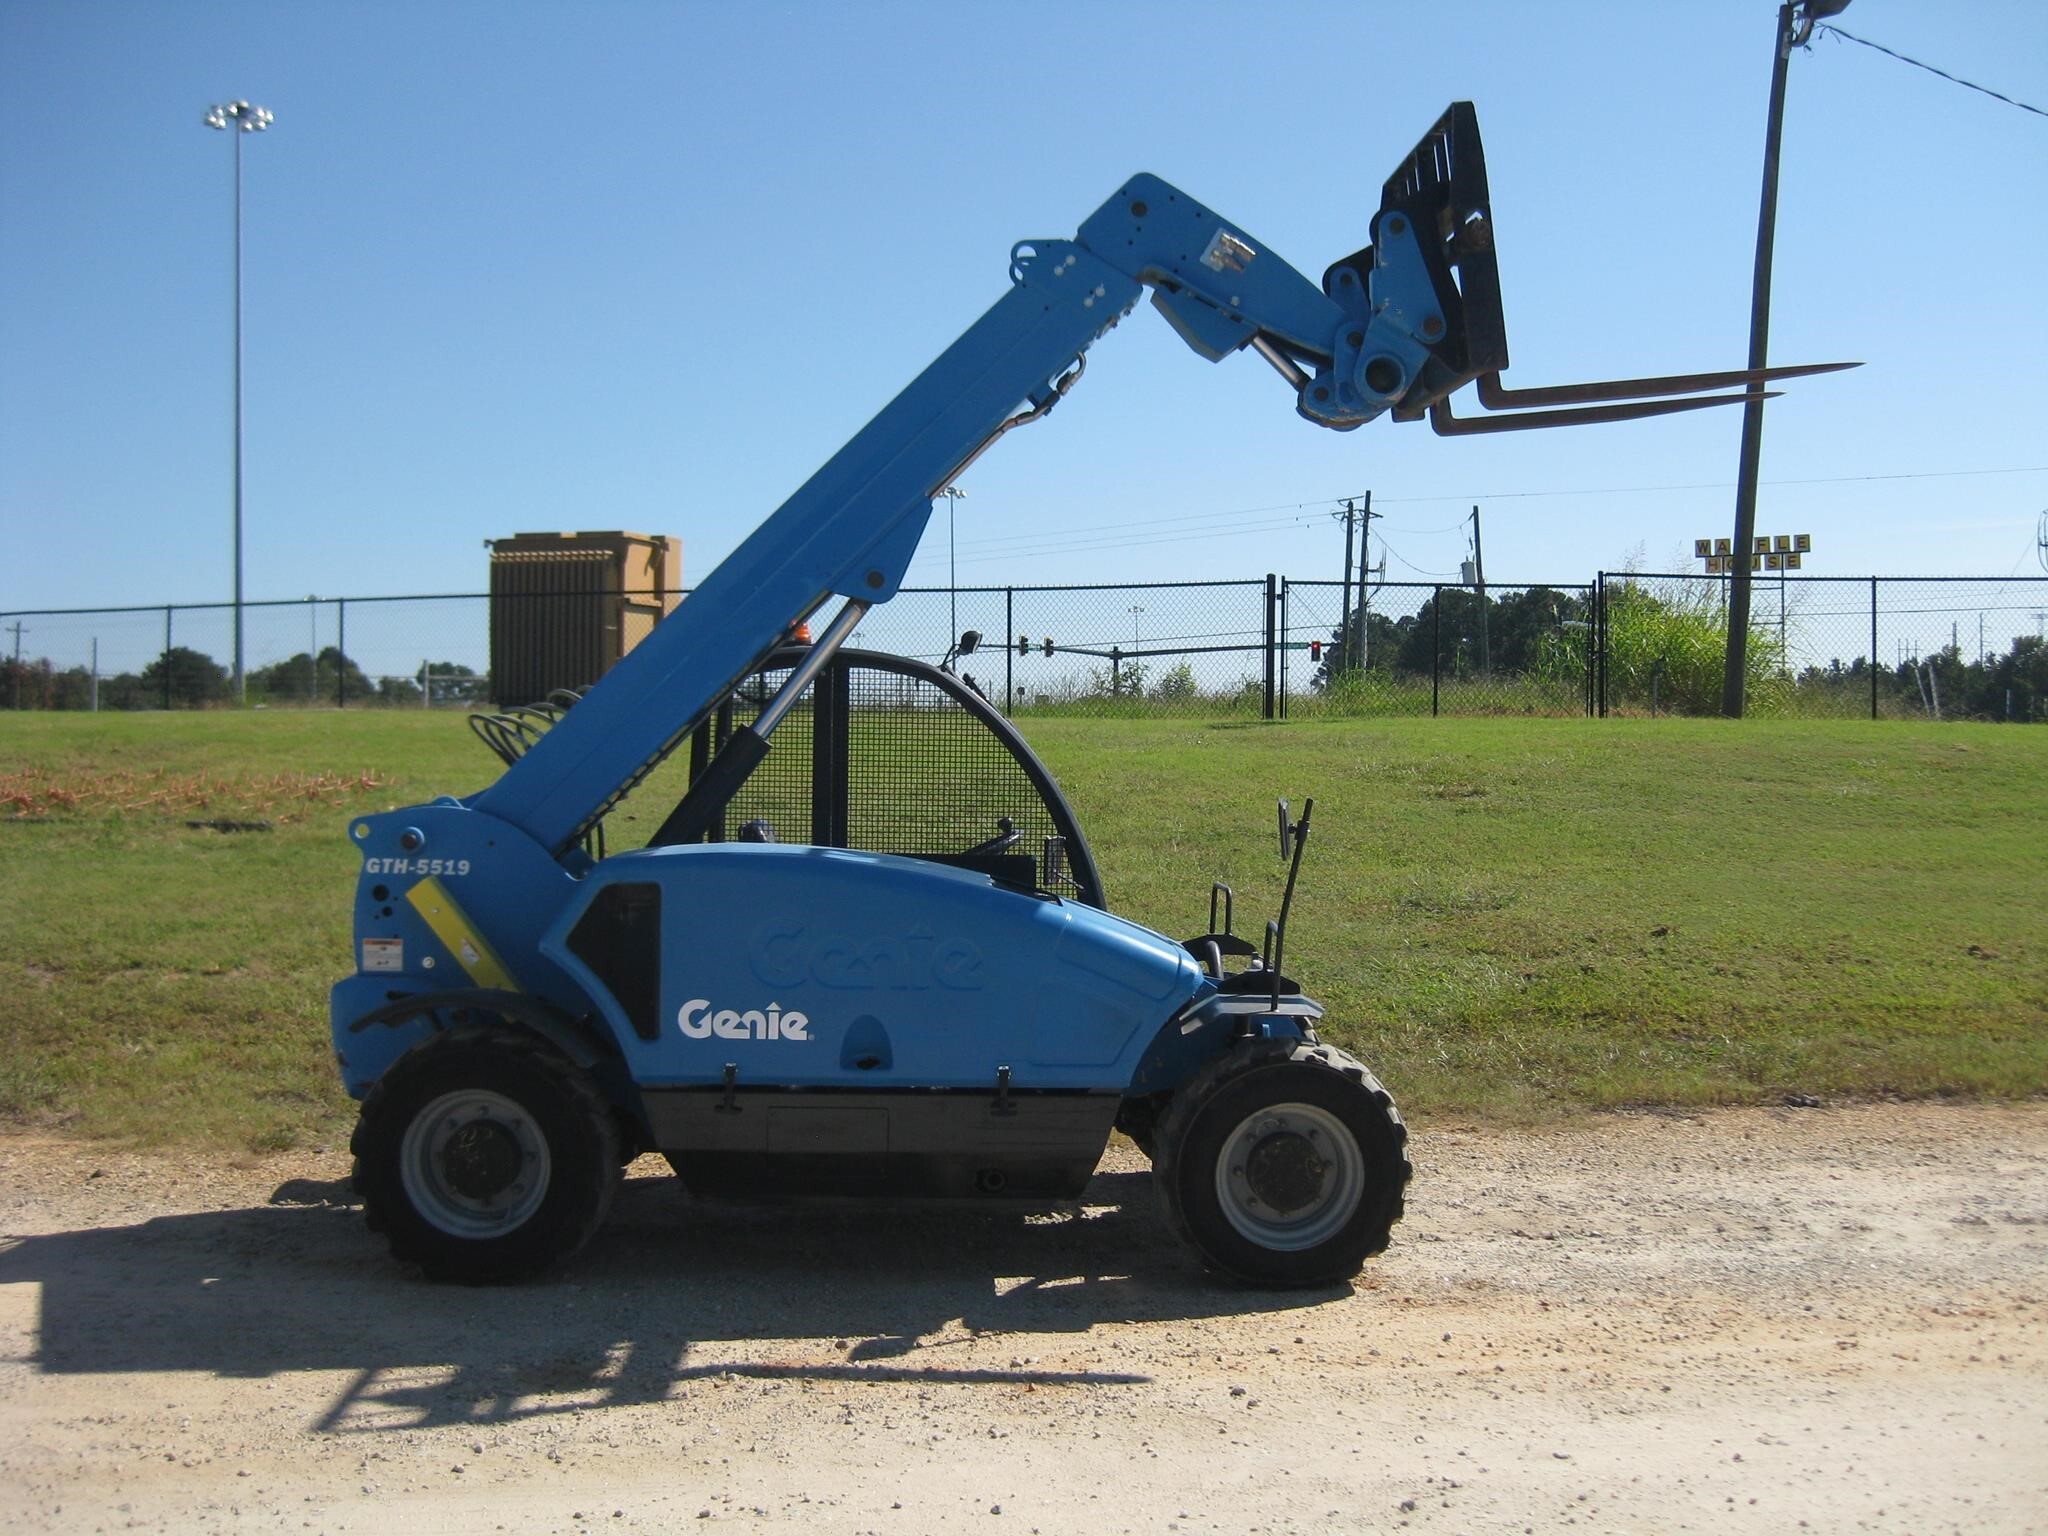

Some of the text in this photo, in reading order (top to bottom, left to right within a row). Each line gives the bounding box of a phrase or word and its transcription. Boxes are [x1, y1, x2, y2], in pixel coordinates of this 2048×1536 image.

[1696, 536, 1808, 554] WAFLE
[366, 858, 470, 876] GTH-5519
[751, 918, 984, 991] Genie
[678, 999, 809, 1040] Genie
